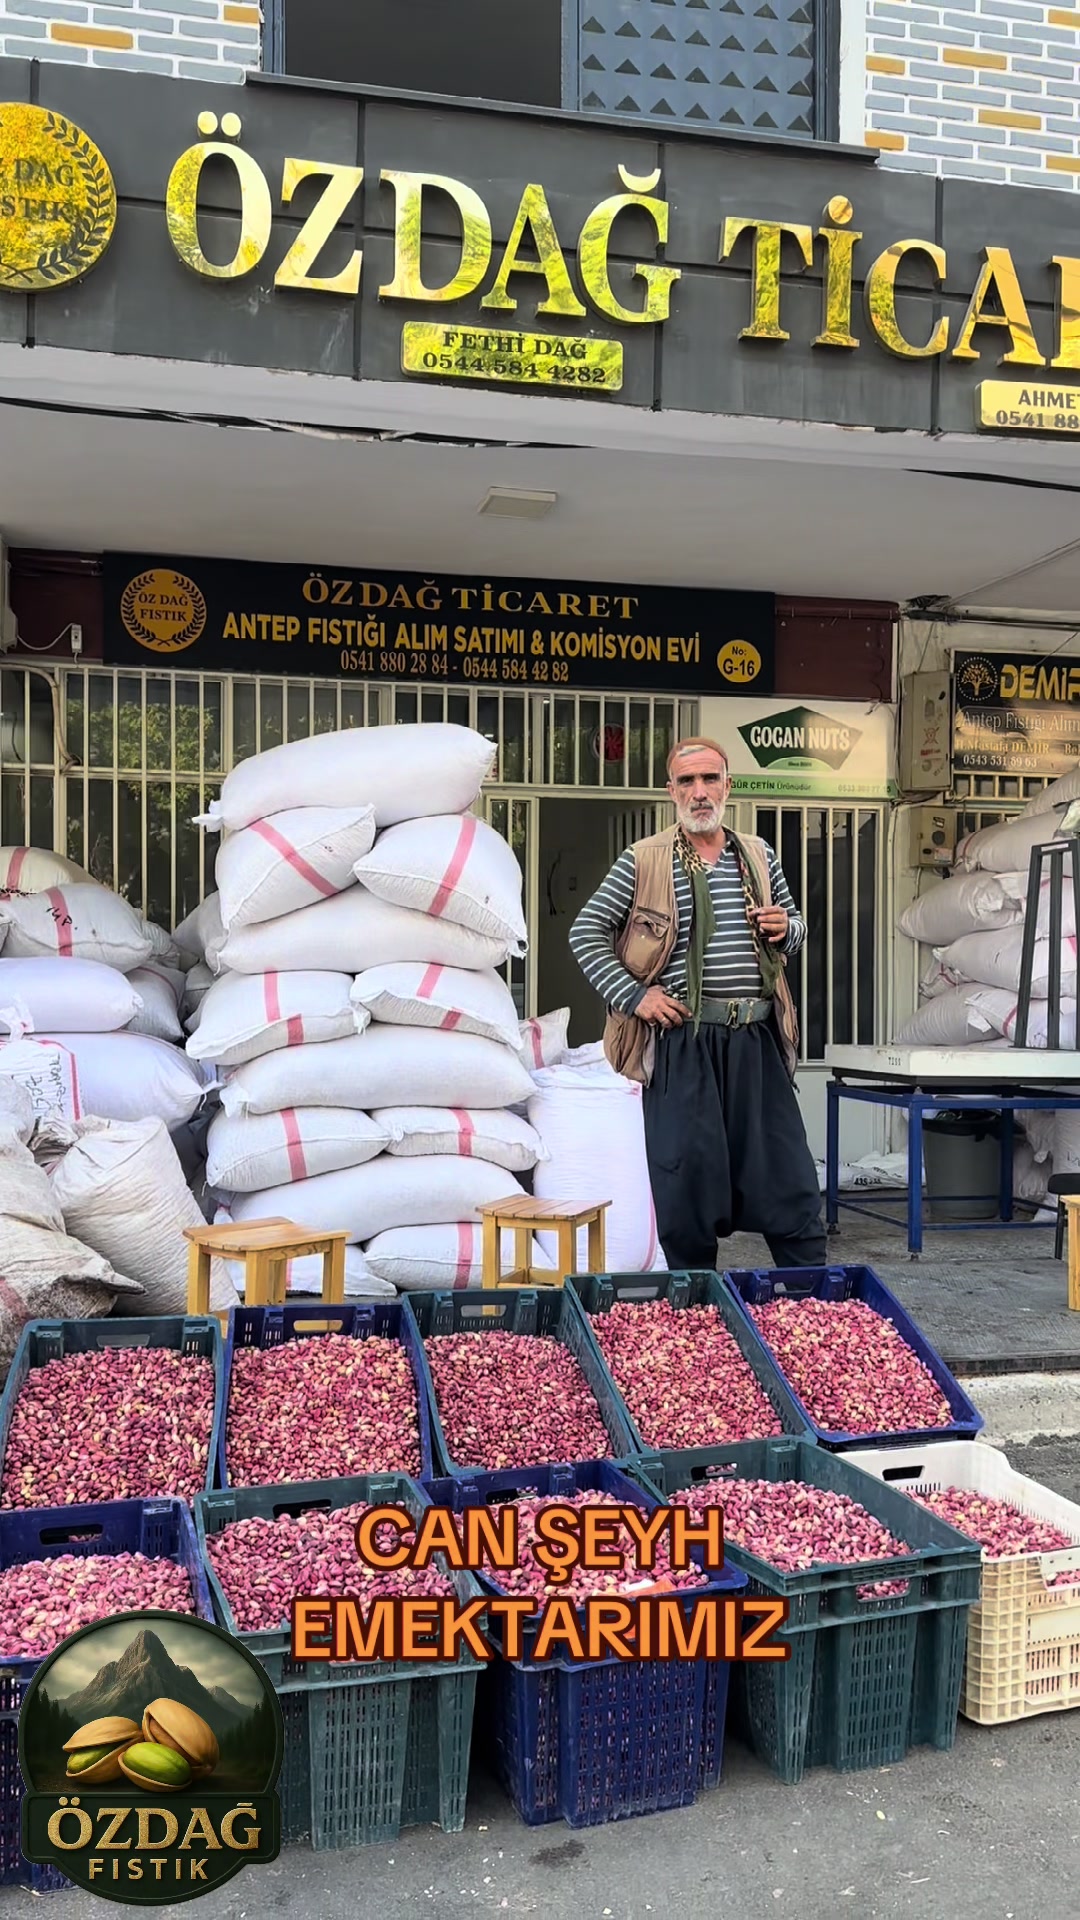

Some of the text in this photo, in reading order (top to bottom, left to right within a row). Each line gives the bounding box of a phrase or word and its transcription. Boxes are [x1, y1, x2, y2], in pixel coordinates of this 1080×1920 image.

[14, 157, 75, 188] DAĞ
[166, 110, 682, 325] ÖZDAĞ
[443, 331, 588, 360] FETHİ DAĞ
[422, 352, 606, 383] 0544 584 4282
[1018, 389, 1080, 410] AHME
[996, 410, 1045, 428] 0541
[138, 591, 188, 607] ÖZ DAĞ
[302, 572, 639, 619] ÖZDAĞ TİCARET
[140, 608, 187, 622] FISTIK
[222, 612, 700, 663] ANTEP FISTIĞI ALIM SATIMI & KOMİSYON EVİ
[340, 649, 375, 671] 0541
[380, 651, 406, 673] 880
[410, 652, 427, 674] 28
[431, 653, 448, 676] 84
[463, 656, 498, 679] 0544
[502, 658, 528, 680] 584
[531, 660, 549, 682] 42
[552, 661, 569, 682] 82
[722, 657, 755, 676] G-16
[963, 711, 1001, 732] Antep
[808, 727, 850, 751] NUTS
[963, 754, 988, 765] 0543
[990, 755, 1007, 766] 531
[750, 780, 775, 790] ÇETİN
